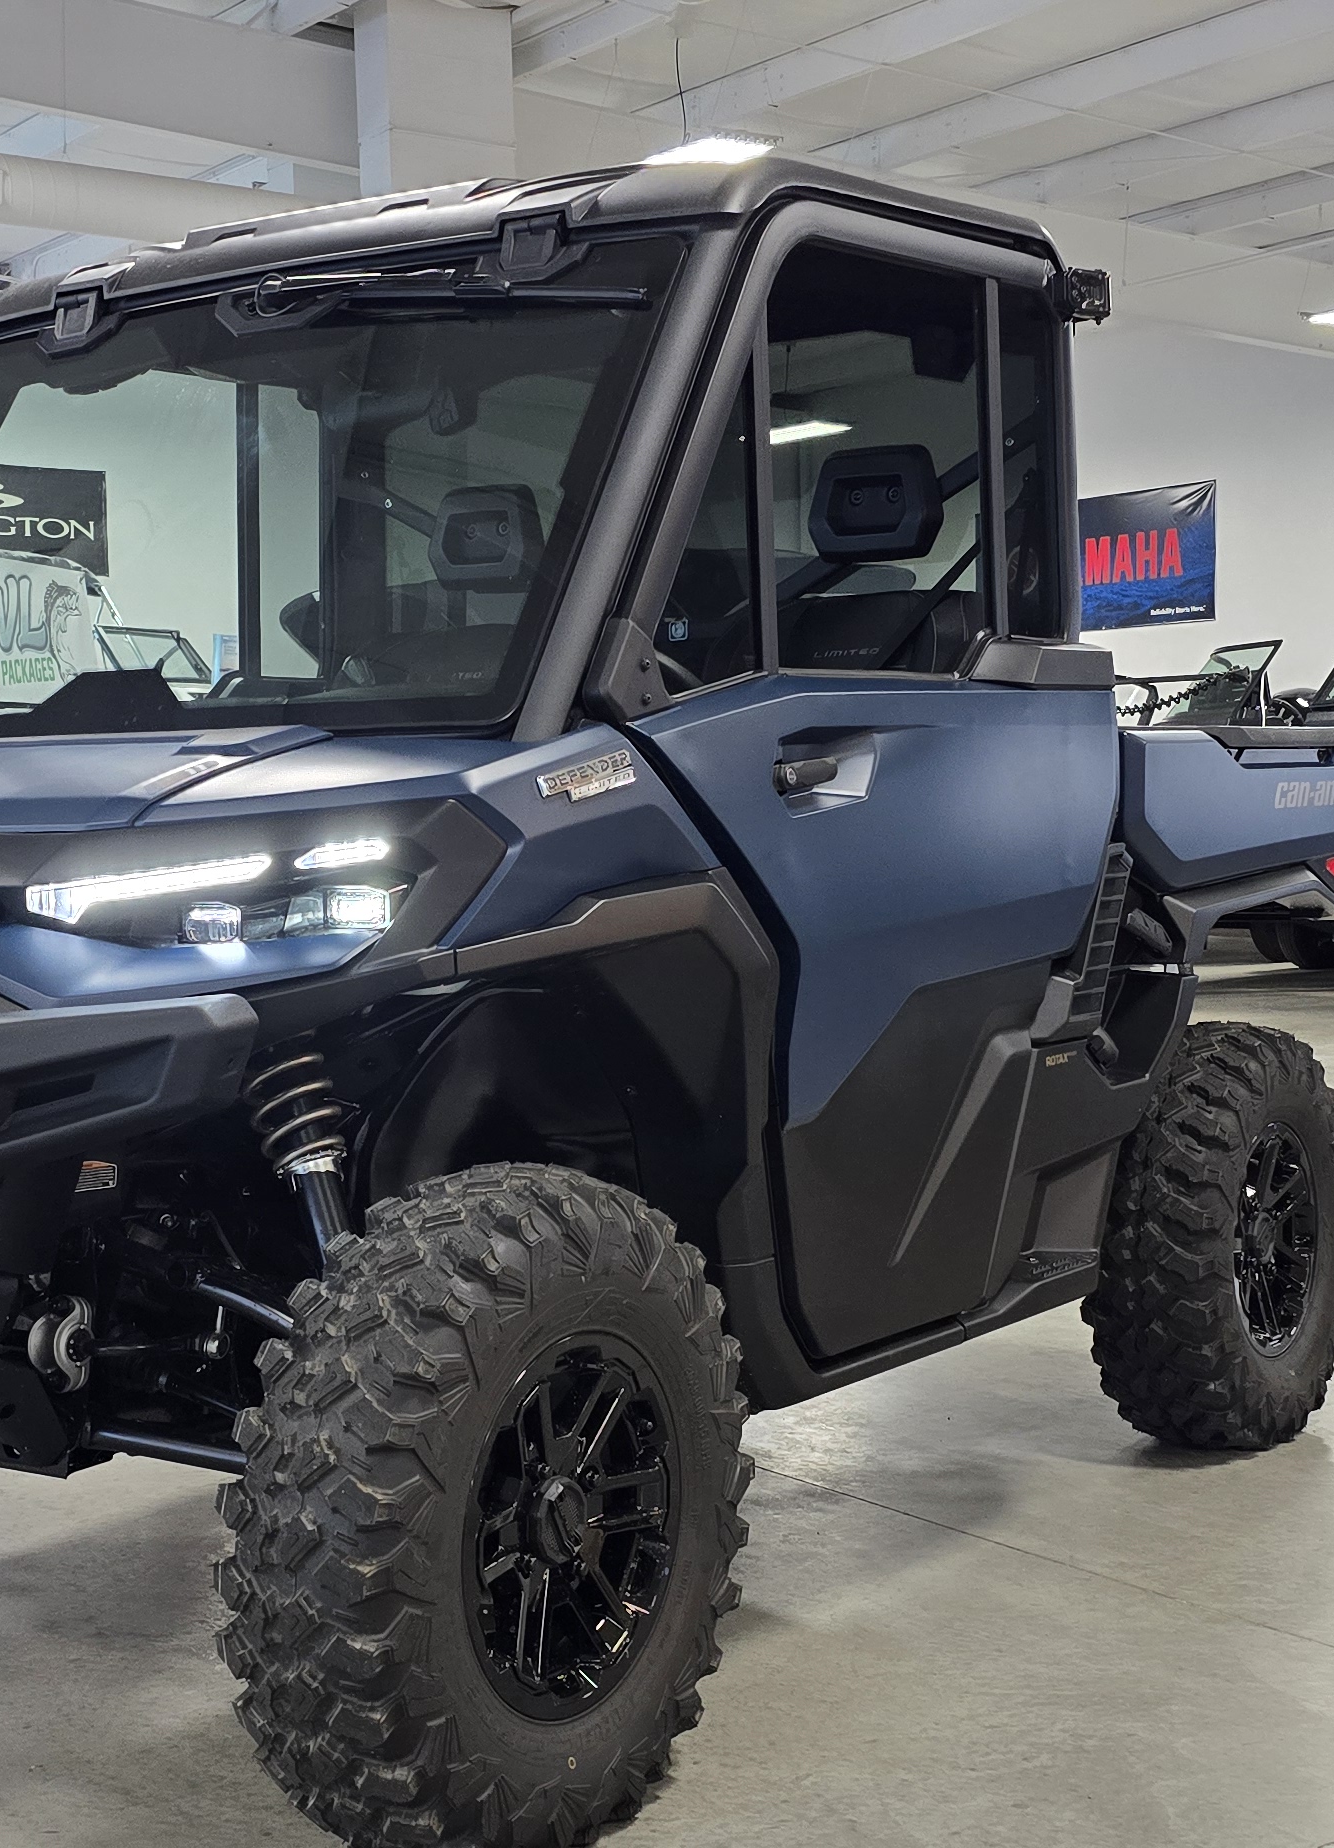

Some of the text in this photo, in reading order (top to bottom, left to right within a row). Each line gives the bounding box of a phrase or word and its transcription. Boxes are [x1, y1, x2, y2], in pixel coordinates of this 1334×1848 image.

[1081, 527, 1184, 586] MAHA
[813, 647, 880, 659] LIMITED
[1, 656, 55, 686] PACKAGES
[545, 751, 630, 790] DEFENDER
[1045, 1053, 1069, 1067] ROTAX
